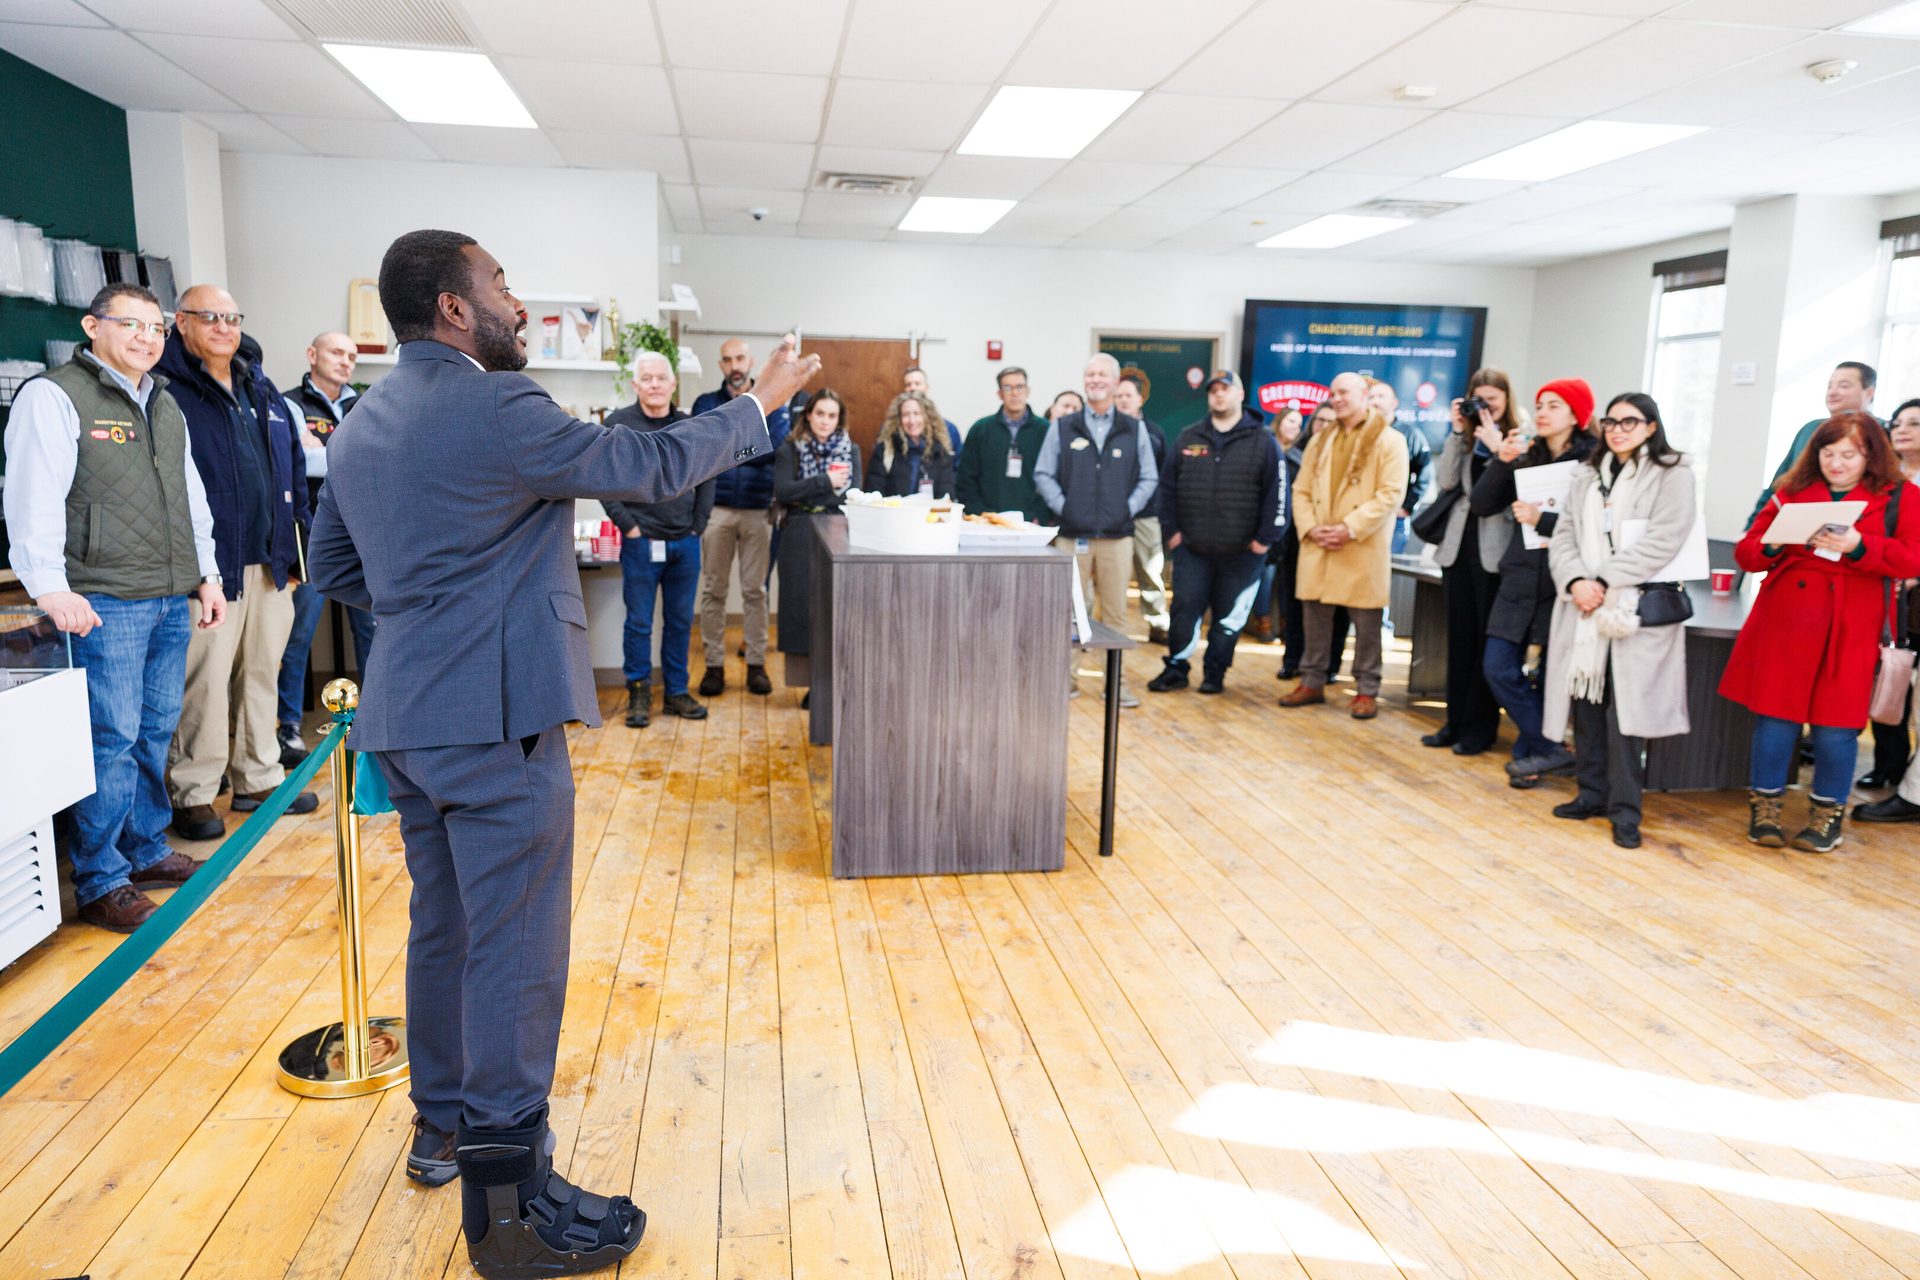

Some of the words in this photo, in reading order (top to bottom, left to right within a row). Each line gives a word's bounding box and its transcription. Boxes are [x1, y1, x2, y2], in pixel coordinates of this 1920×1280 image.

[1308, 323, 1375, 336] CHARCUTERIE
[1377, 325, 1424, 338] ARTISANS
[1270, 343, 1294, 352] HOME
[1294, 343, 1307, 353] OF
[1307, 344, 1323, 353] THE
